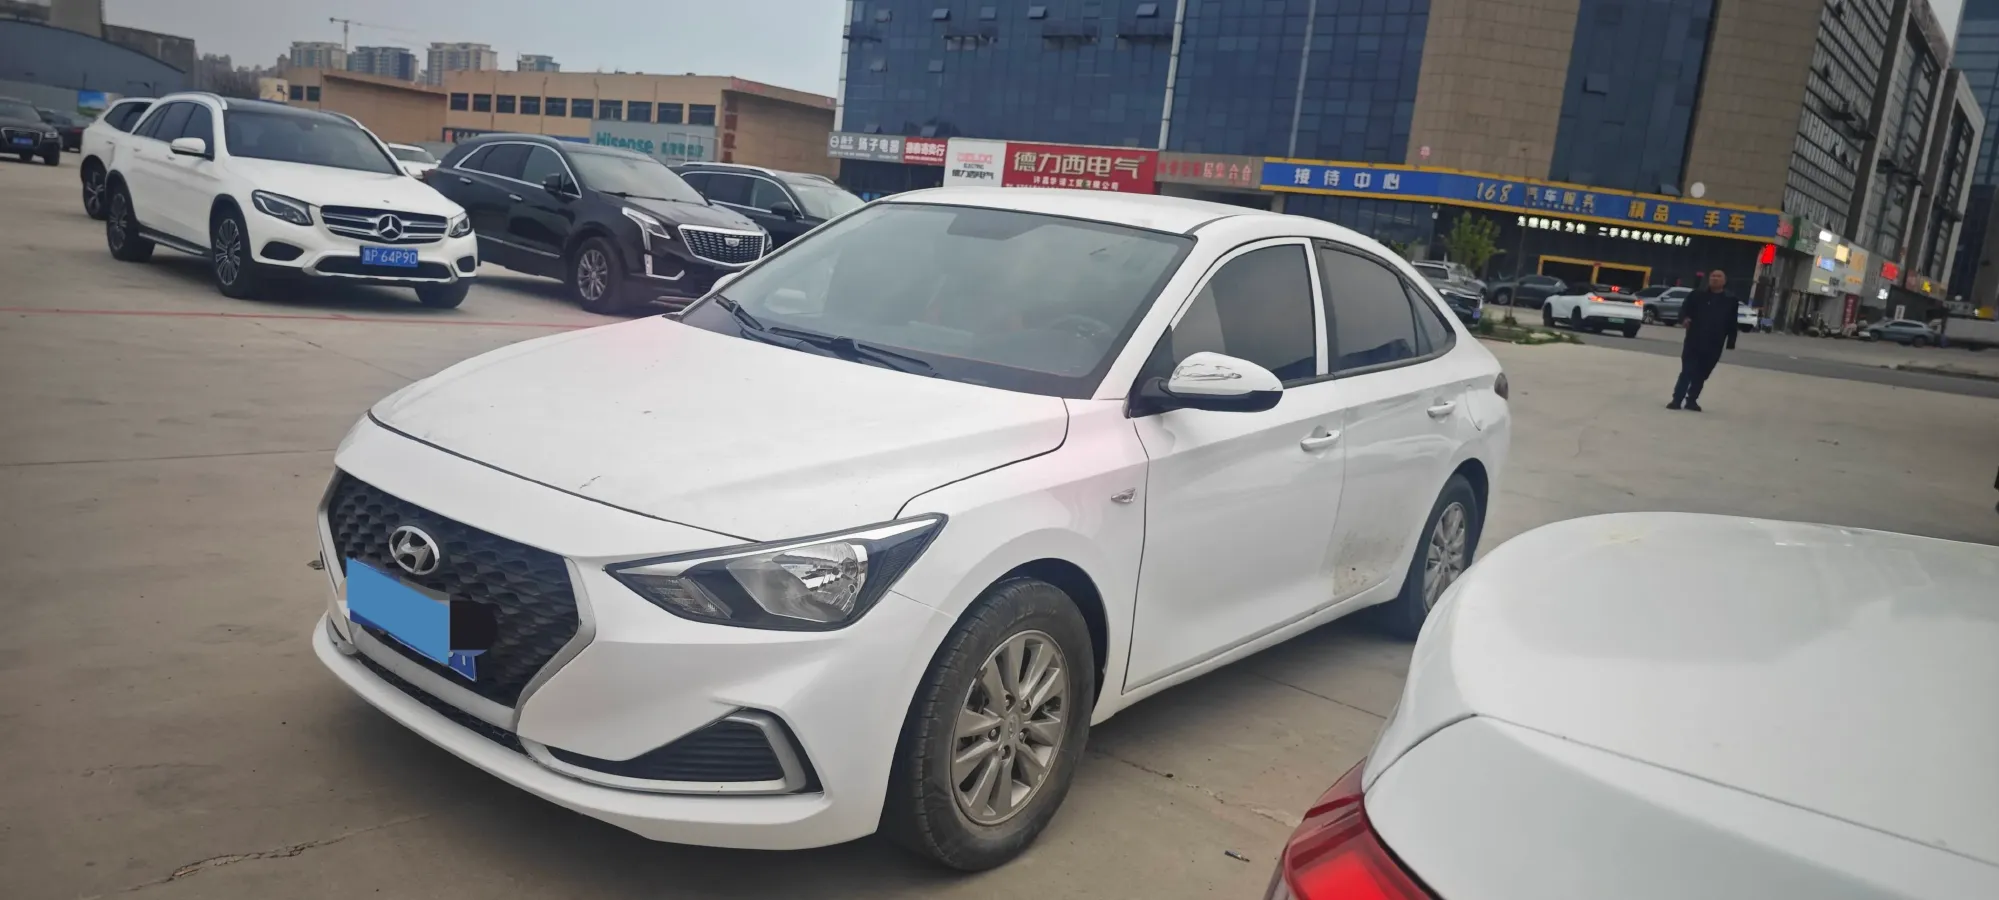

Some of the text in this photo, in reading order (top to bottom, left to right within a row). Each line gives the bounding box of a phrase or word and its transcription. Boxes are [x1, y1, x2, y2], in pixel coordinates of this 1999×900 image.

[596, 132, 655, 154] Hisense
[952, 169, 994, 180] 德力西电气
[1014, 151, 1139, 179] 德力西电气
[1294, 168, 1400, 190] 接待中心
[1477, 182, 1513, 202] 168
